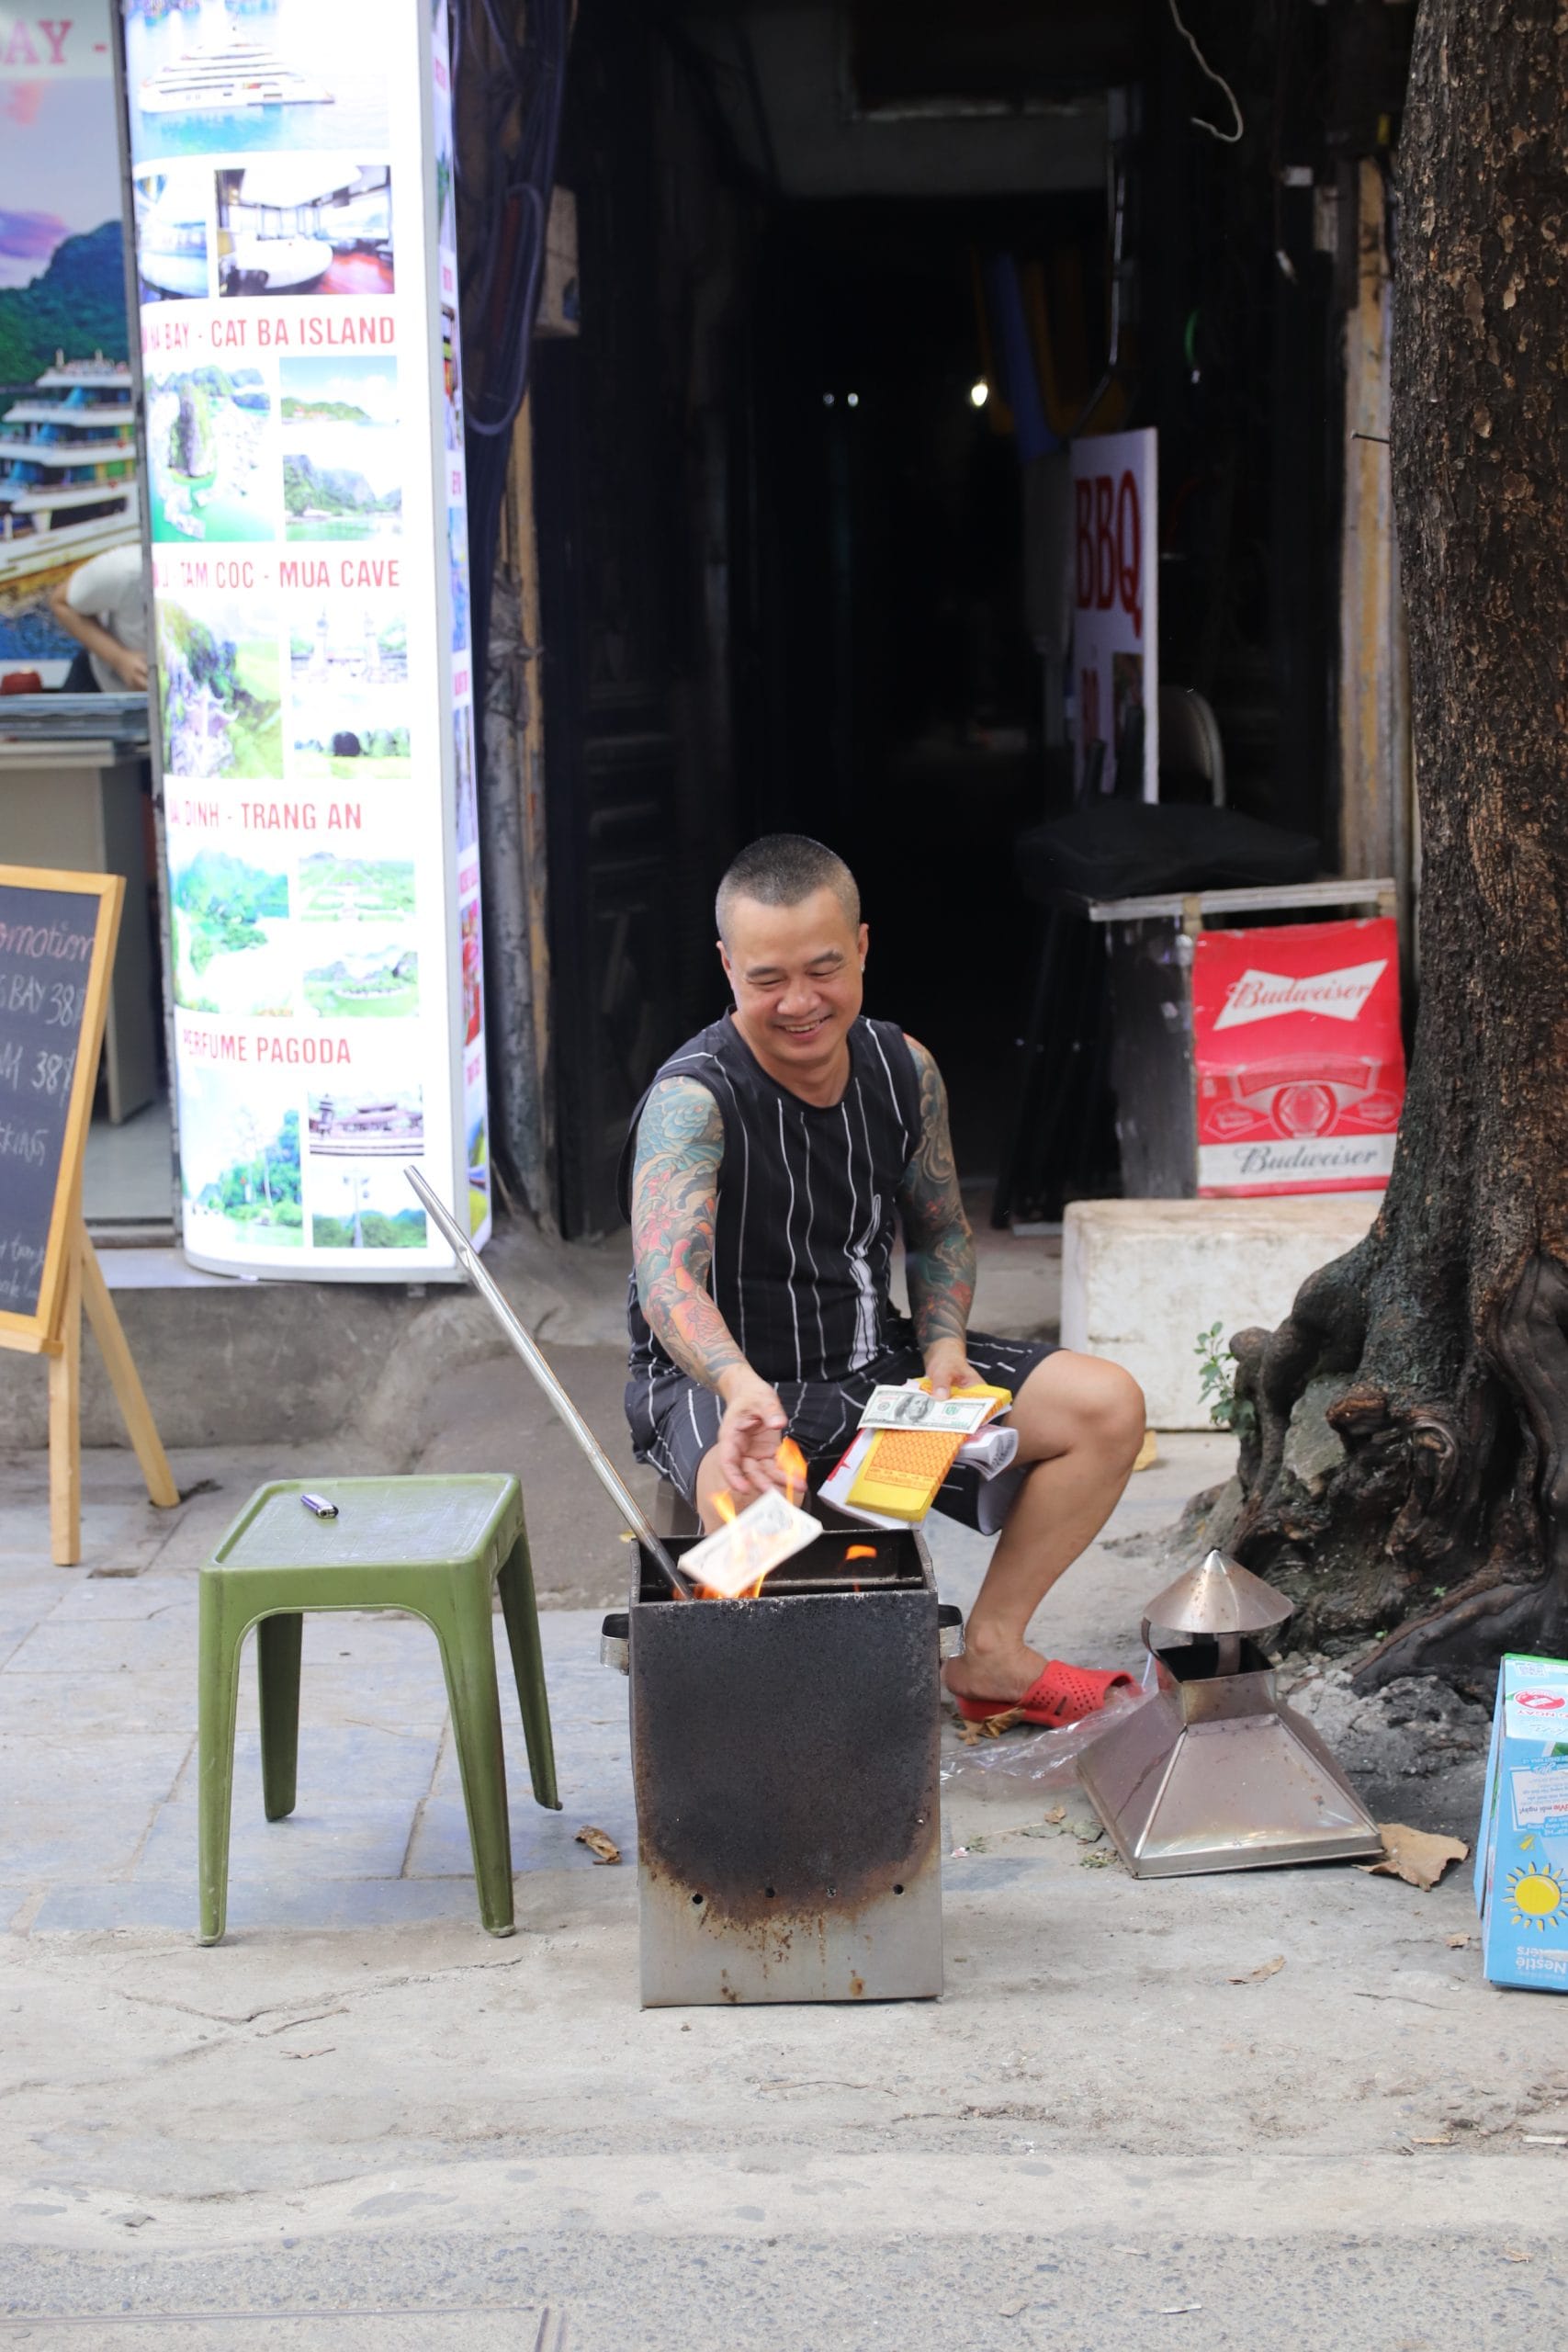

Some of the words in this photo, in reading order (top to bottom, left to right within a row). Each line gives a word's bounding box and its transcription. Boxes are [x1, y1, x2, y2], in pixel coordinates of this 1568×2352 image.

[2, 17, 73, 66] AY
[211, 319, 247, 347] CAT
[257, 319, 289, 346] BA
[299, 316, 395, 345] ISLAND
[1074, 468, 1142, 639] BBQ
[216, 560, 254, 589] COC
[278, 560, 331, 589] MUA
[340, 560, 400, 588] CAVE
[241, 802, 317, 831] TRANG
[328, 802, 363, 831] AN
[1226, 978, 1371, 1011] Budweiser
[256, 1036, 351, 1065] PAGODA
[1234, 1144, 1379, 1176] Budweiser
[1516, 1956, 1566, 1973] Nestlé
